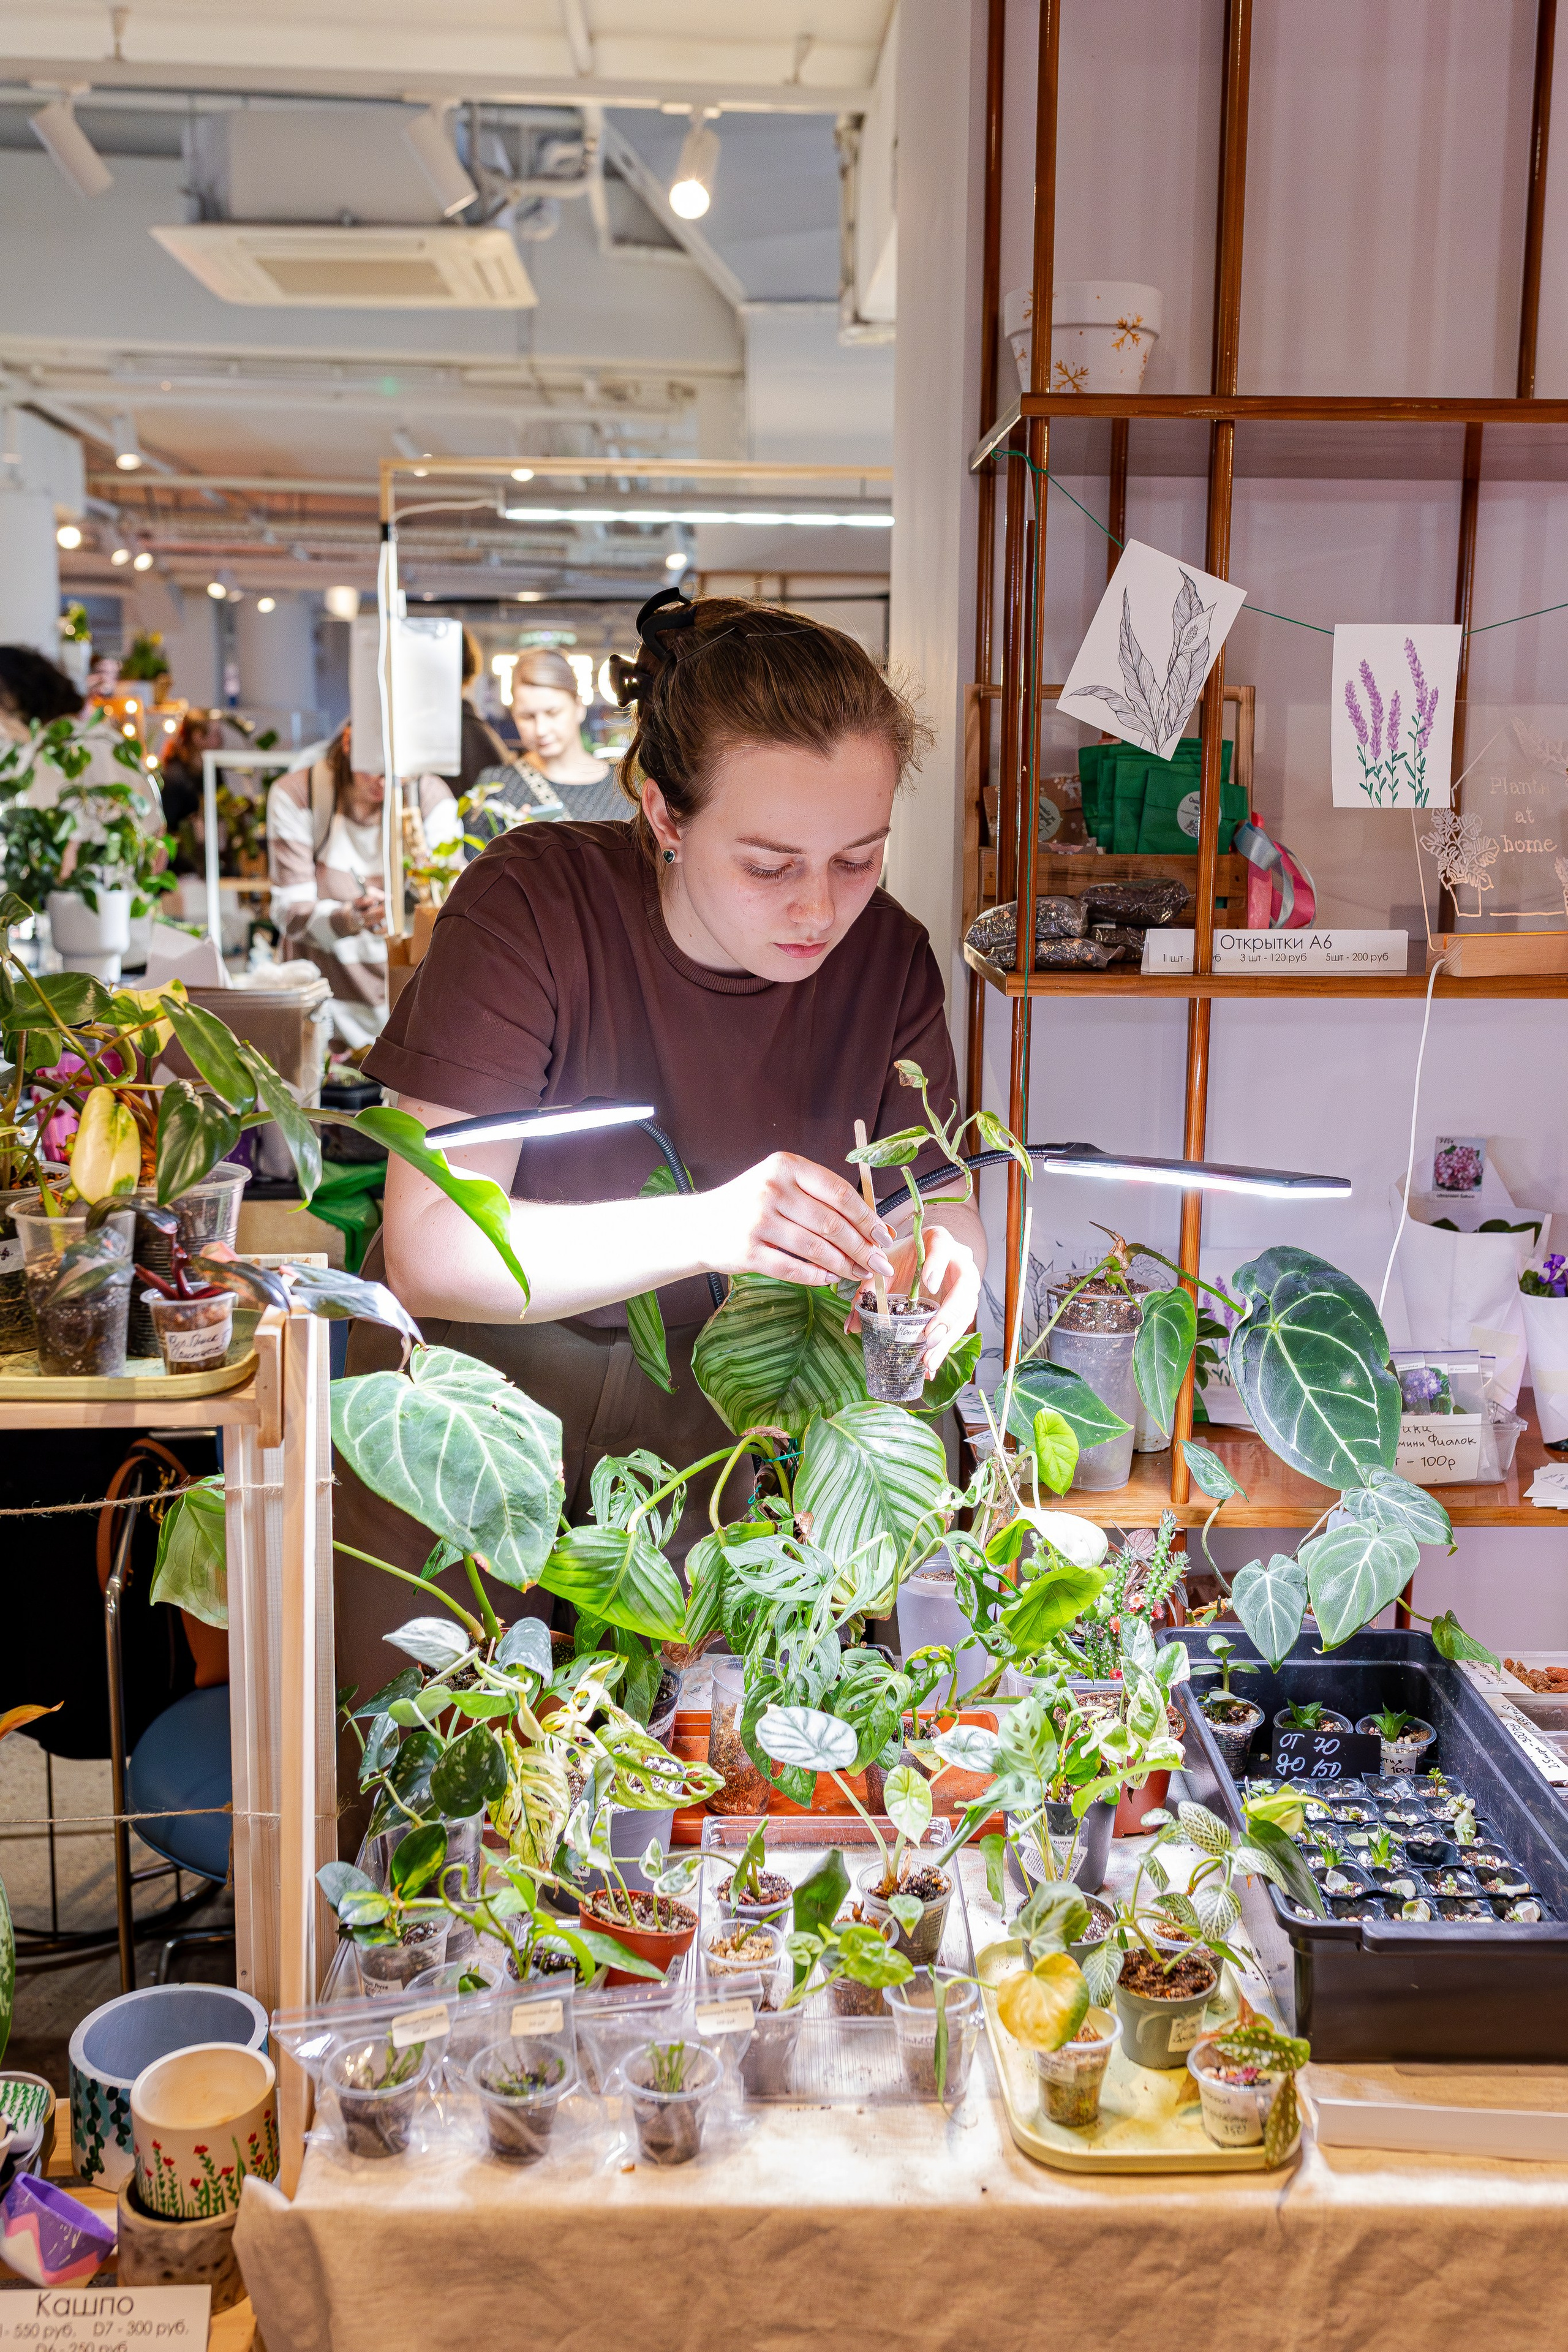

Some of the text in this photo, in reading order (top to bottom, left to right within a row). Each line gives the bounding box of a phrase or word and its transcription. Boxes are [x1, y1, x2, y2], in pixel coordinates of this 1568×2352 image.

[1515, 806, 1535, 824] at
[1500, 834, 1558, 853] home
[1221, 934, 1303, 953] Открытки
[1163, 954, 1166, 962] 1
[1240, 953, 1246, 962] 3
[1270, 953, 1286, 962] 120
[1289, 953, 1307, 963] руб
[1325, 953, 1344, 962] 5шт
[1352, 952, 1368, 962] 200
[1371, 952, 1389, 963] руб
[1402, 1425, 1432, 1433] ики
[1428, 1433, 1477, 1446] Фиалок
[1421, 1455, 1456, 1471] 100р
[1313, 1736, 1340, 1755] 70
[1311, 1758, 1341, 1777] 150
[37, 2292, 134, 2318] Кашпо
[126, 2320, 153, 2337] 300
